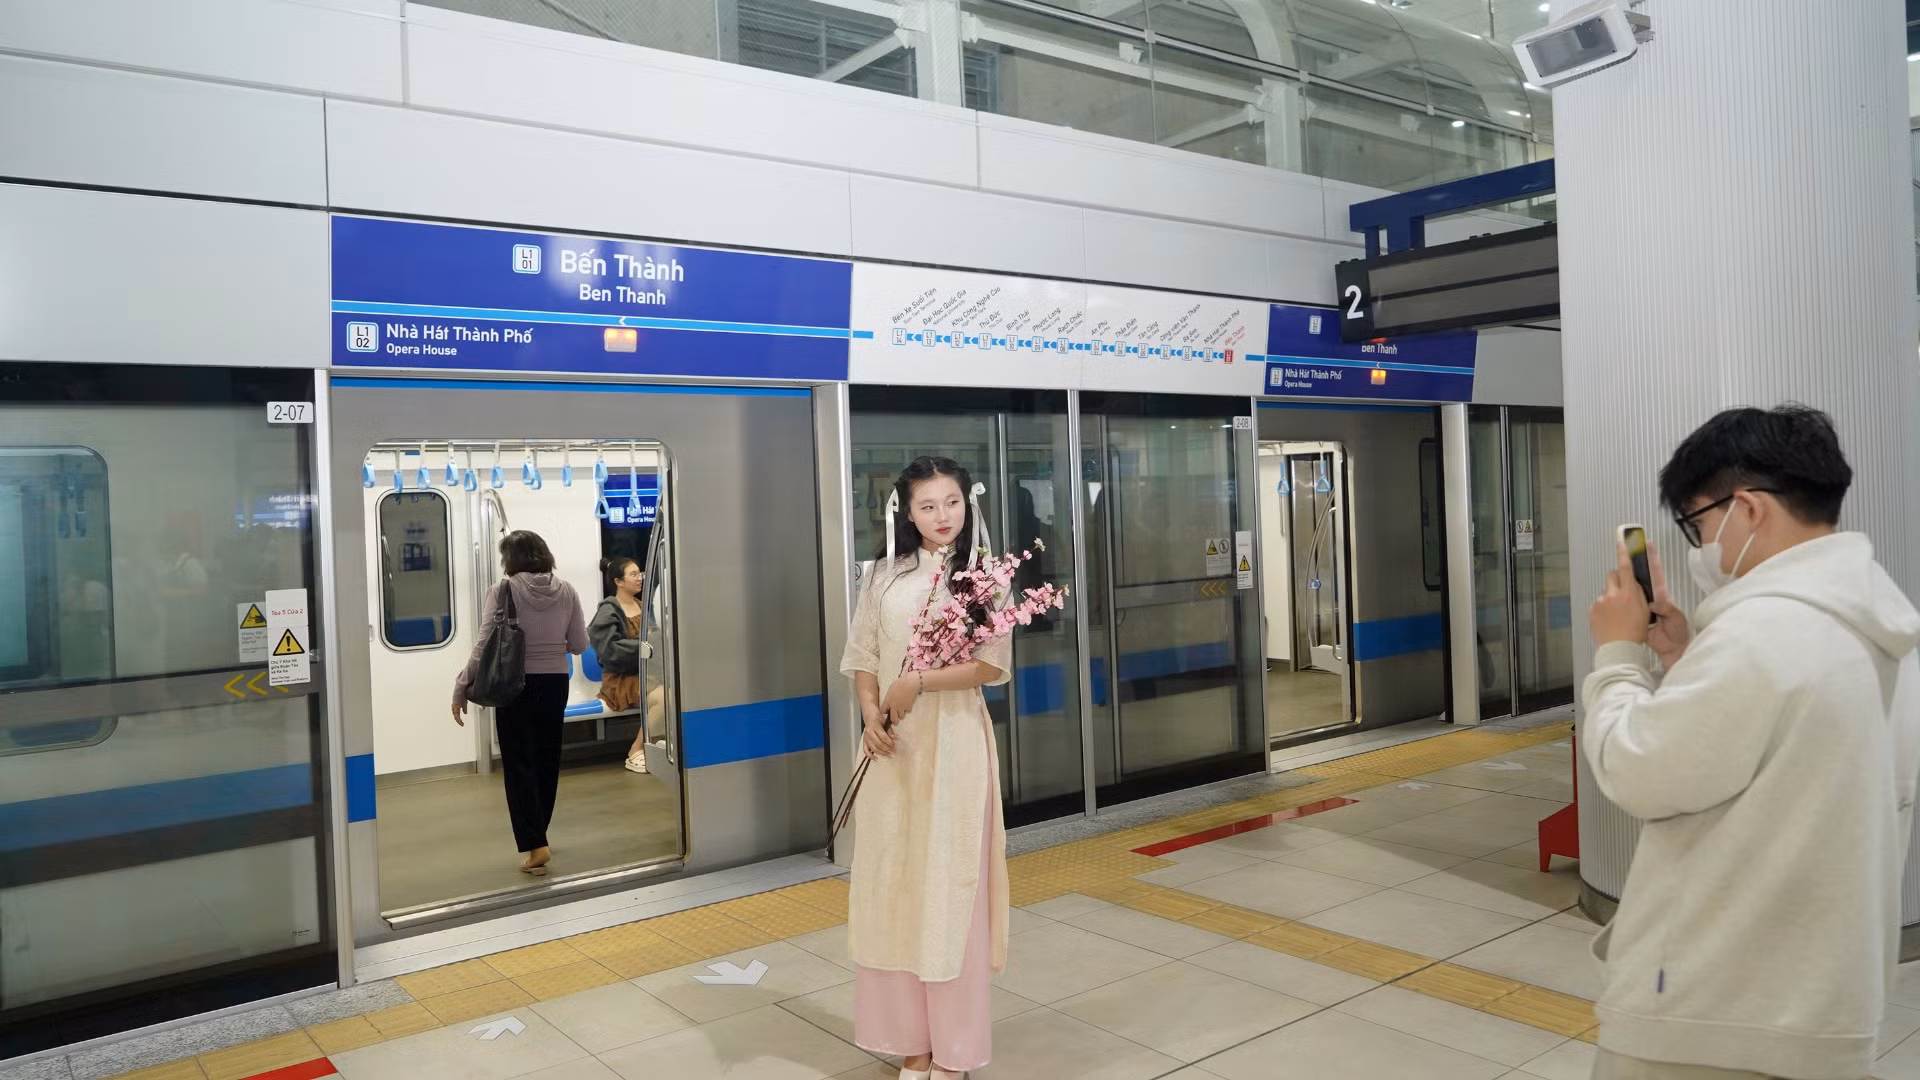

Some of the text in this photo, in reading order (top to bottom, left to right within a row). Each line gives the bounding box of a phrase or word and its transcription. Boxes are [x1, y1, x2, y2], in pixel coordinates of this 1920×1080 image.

[522, 250, 532, 258] L1
[522, 260, 532, 270] 01
[560, 249, 684, 282] Bến Thành
[580, 284, 666, 305] Ben Thanh
[1345, 284, 1364, 320] 2
[356, 326, 369, 336] L1
[386, 323, 534, 344] Nhà Hát Thành Phố
[356, 338, 370, 348] 02
[1377, 343, 1398, 355] Thanh
[386, 343, 457, 356] Opera House
[1285, 368, 1342, 380] Nhà Hát Thành Phố
[274, 404, 304, 420] 2-07
[1237, 418, 1248, 428] 2-08
